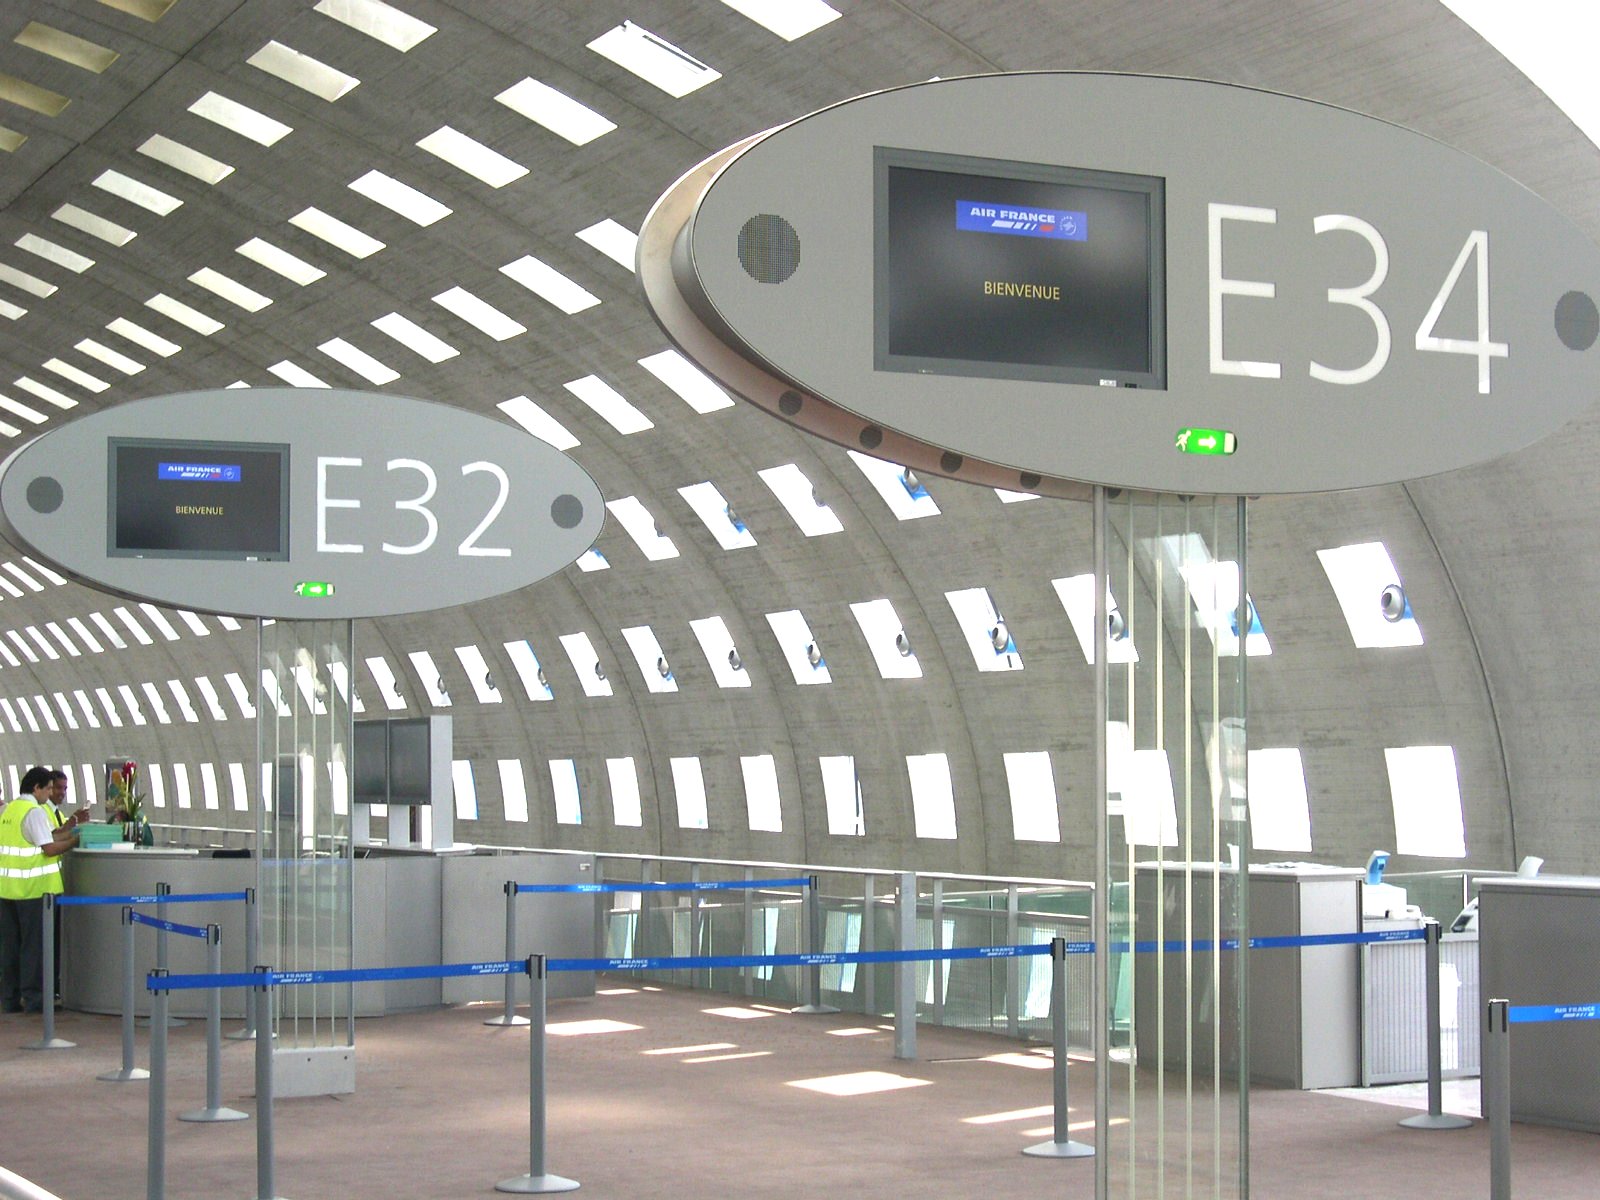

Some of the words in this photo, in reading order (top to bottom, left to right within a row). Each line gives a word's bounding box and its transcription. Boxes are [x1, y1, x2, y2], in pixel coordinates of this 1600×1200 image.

[970, 207, 996, 218] AIR
[1000, 210, 1055, 223] FRANCE
[984, 280, 1060, 300] BIENVENUE
[1208, 203, 1509, 394] E34
[175, 506, 224, 516] BIENVENUE
[316, 456, 512, 557] E32
